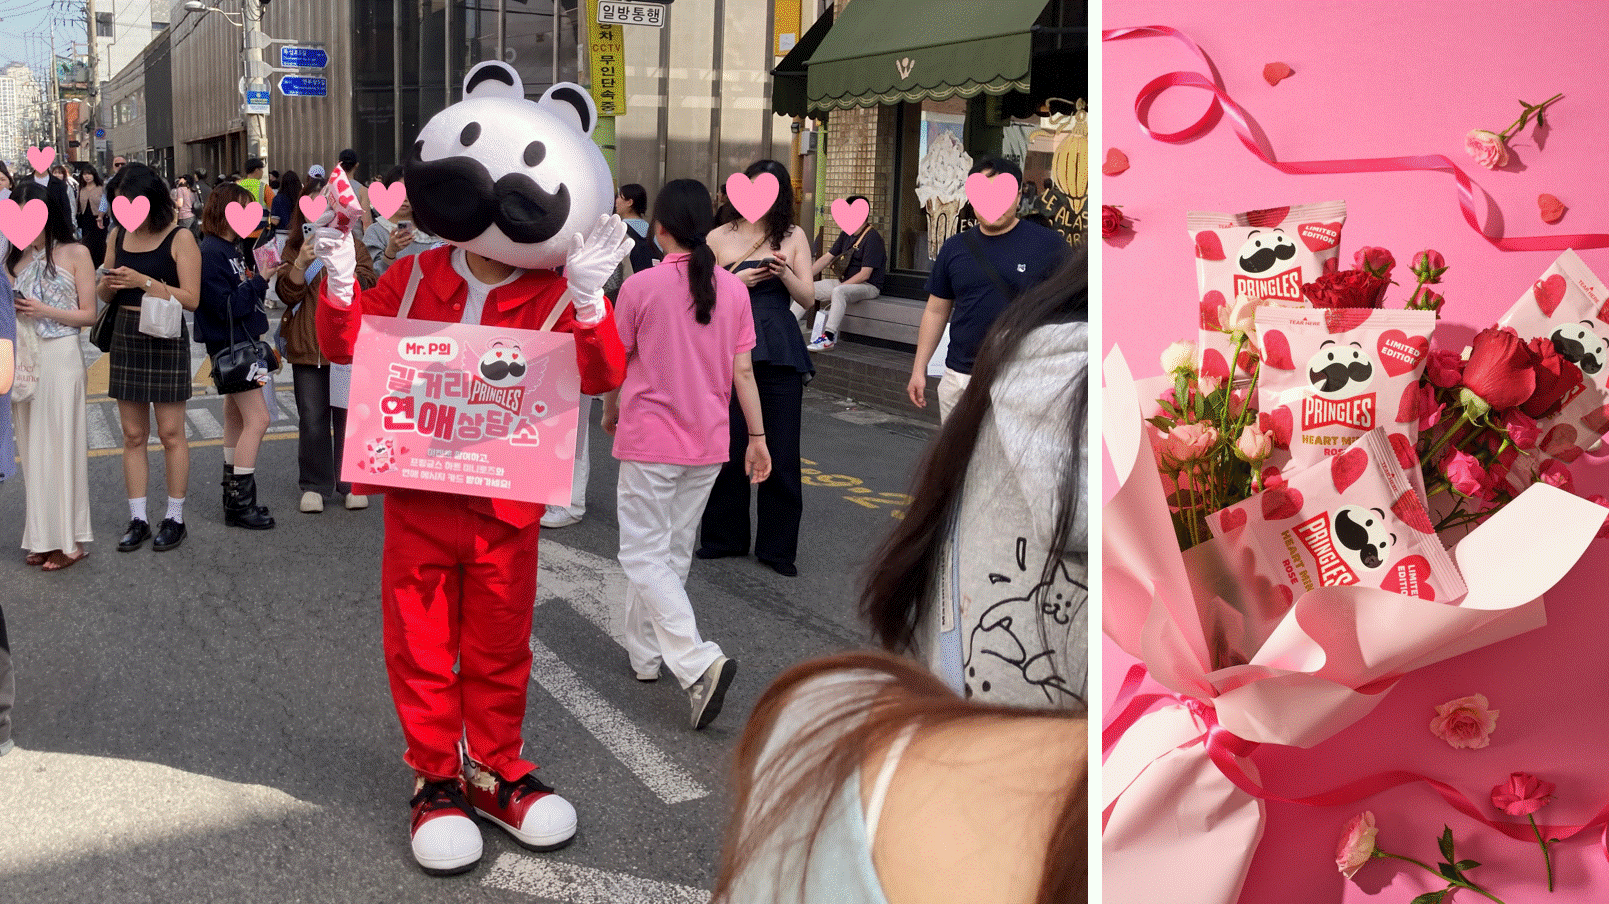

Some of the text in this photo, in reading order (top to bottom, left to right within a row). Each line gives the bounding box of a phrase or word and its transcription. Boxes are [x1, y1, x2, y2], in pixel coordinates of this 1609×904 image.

[603, 5, 660, 23] 일방통행
[592, 43, 621, 52] CCTV
[600, 55, 616, 112] 무인단속중
[1041, 187, 1057, 211] LE
[1302, 230, 1335, 245] EDITION
[1305, 225, 1337, 238] LIMITED
[1237, 271, 1300, 299] PRINGLES
[1385, 338, 1420, 357] LIMITED
[387, 363, 470, 399] 길거리
[470, 379, 522, 412] PRINGLES
[1304, 395, 1372, 428] PRINGLES
[1302, 434, 1360, 446] HEART MI
[1324, 448, 1346, 456] ROS
[1281, 529, 1315, 592] HEART MIN
[1298, 517, 1353, 587] PRINGLES
[1282, 558, 1299, 585] ROSE
[1397, 565, 1409, 596] EDITIO
[1407, 564, 1419, 597] LIMITE
